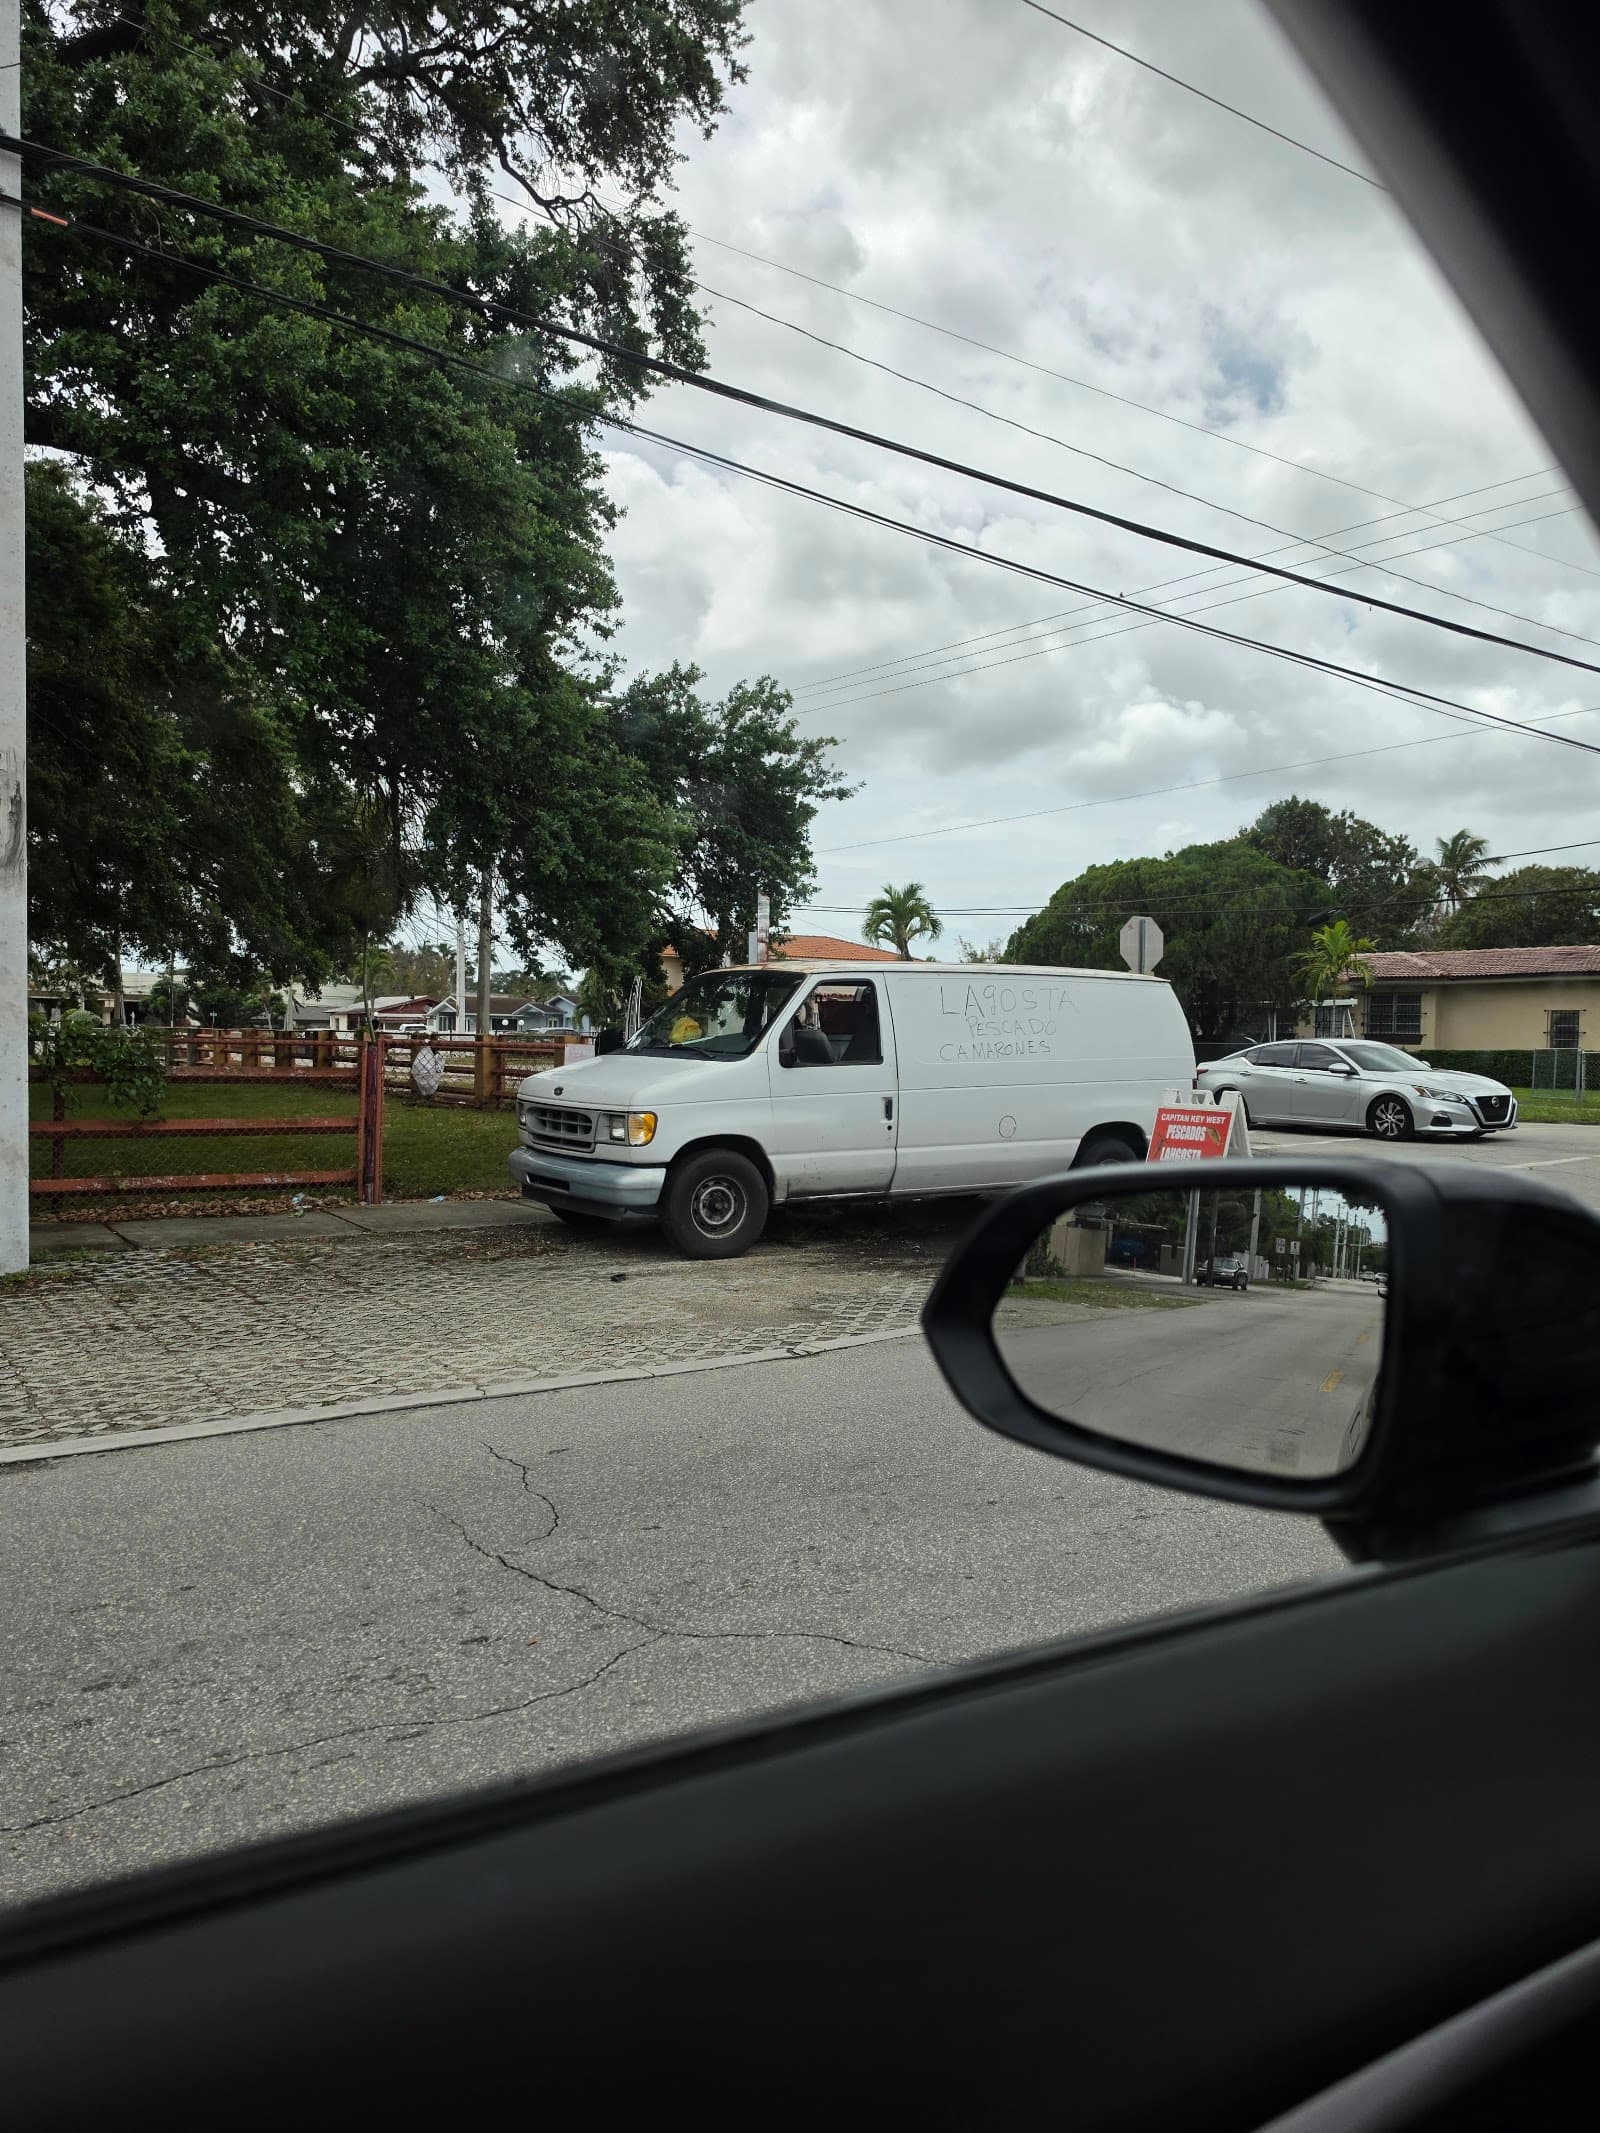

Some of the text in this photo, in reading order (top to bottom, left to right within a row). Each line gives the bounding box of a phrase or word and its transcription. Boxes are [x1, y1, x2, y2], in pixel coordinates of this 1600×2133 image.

[966, 1016, 1057, 1038] PESCADO
[939, 1040, 1052, 1061] CAMARONES
[1161, 1113, 1226, 1125] CAPITAN KEY WEST
[1166, 1124, 1207, 1141] PESCADOS
